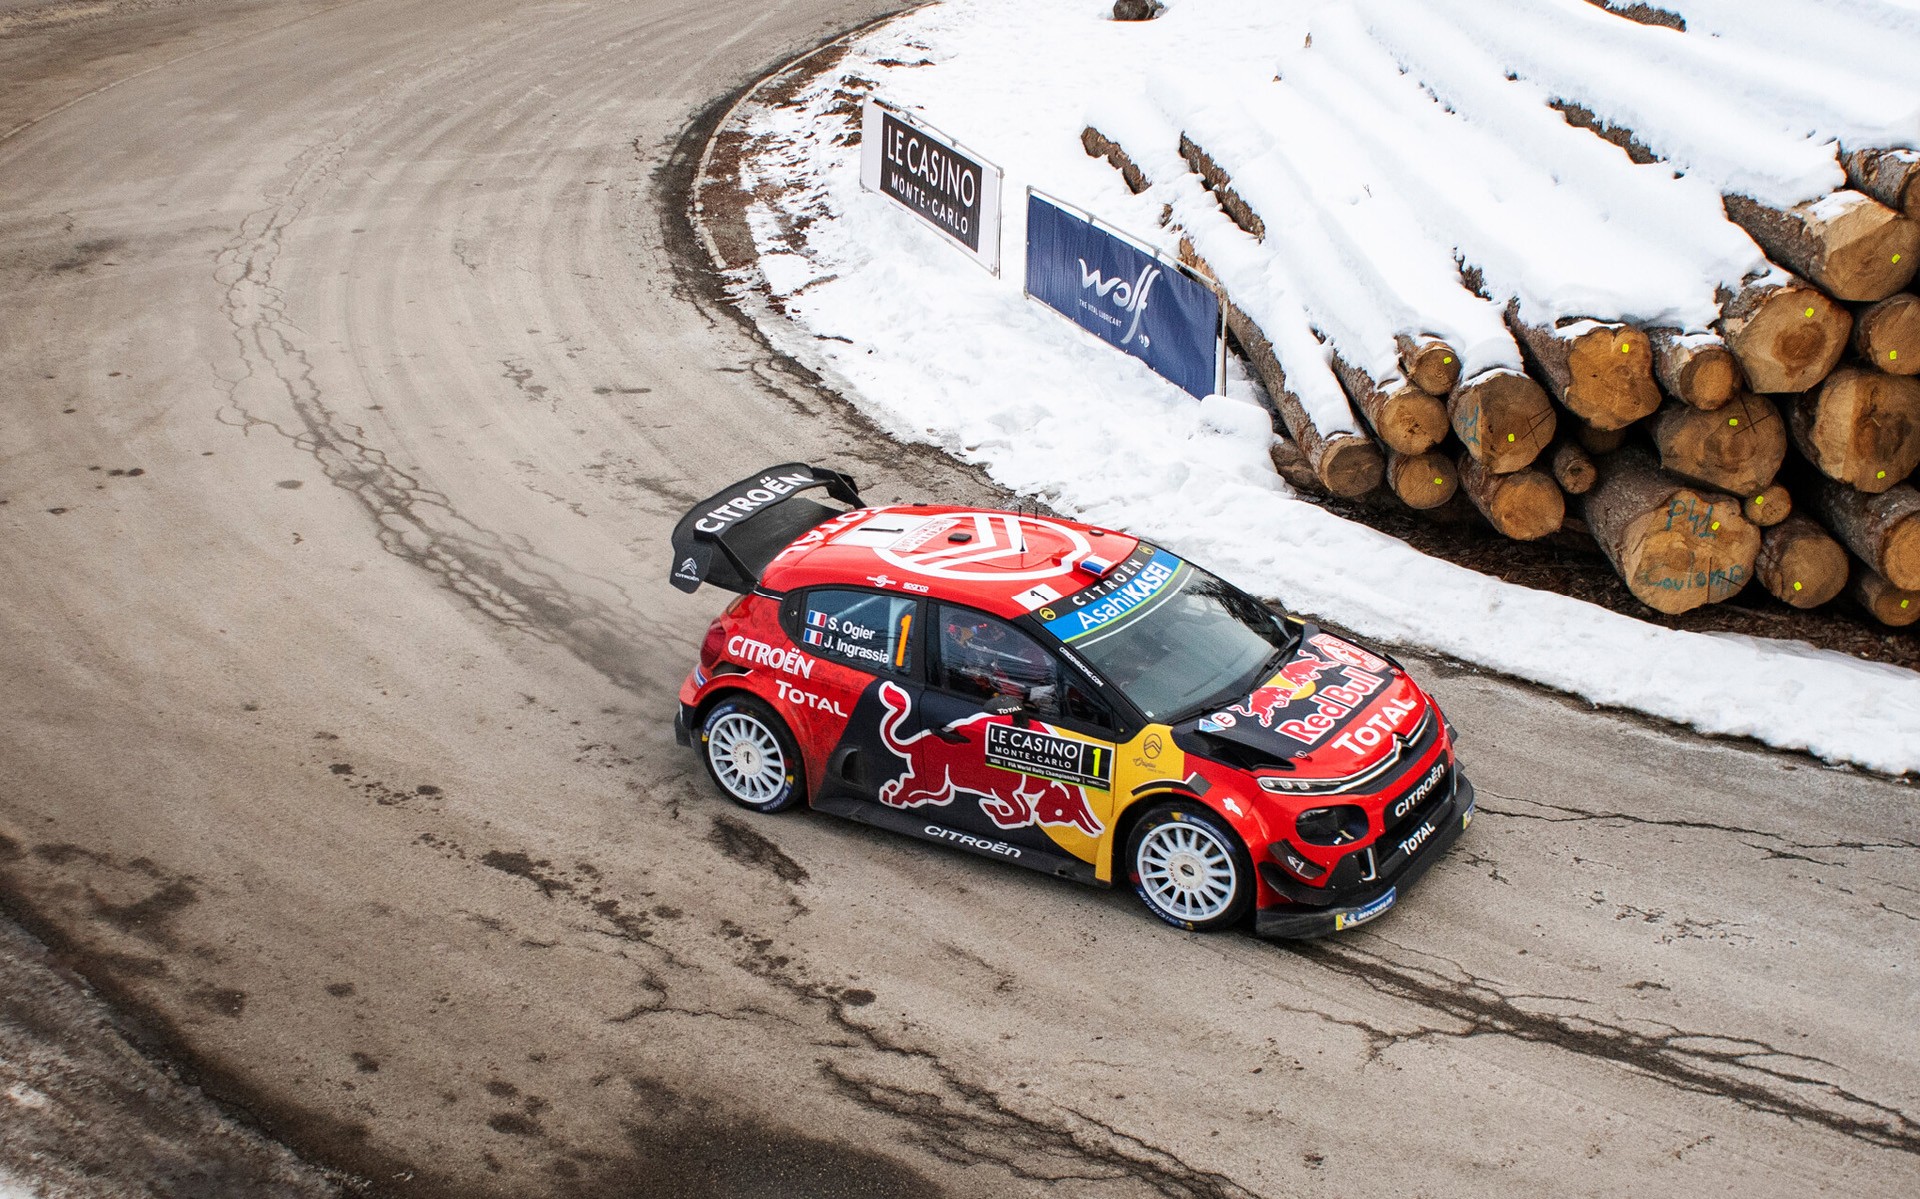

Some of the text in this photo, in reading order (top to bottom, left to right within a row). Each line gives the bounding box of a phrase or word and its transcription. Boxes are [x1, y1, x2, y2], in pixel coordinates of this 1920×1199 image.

[888, 125, 975, 208] LE CASINO
[1079, 258, 1160, 344] wolf
[695, 473, 814, 533] CITROËN
[1031, 590, 1049, 601] 1
[1072, 558, 1144, 606] CITROËN
[1077, 562, 1174, 630] AsahiKASEI
[828, 617, 876, 640] S. Ogier
[895, 614, 912, 667] 1
[728, 635, 815, 679] CITROËN
[824, 636, 890, 664] J. Ingrassia
[776, 679, 848, 718] TOTAL
[997, 705, 1022, 715] TOTAL
[1276, 667, 1383, 744] Red Bull
[990, 728, 1078, 759] LE CASINO
[1331, 698, 1417, 755] TOTAL
[1017, 763, 1032, 772] World
[1032, 766, 1045, 775] Rally
[1045, 768, 1081, 783] Championship
[1093, 748, 1102, 777] 1
[1395, 764, 1444, 818] CITROËN
[924, 825, 1022, 858] CITROËN
[1399, 822, 1436, 856] TOTAL
